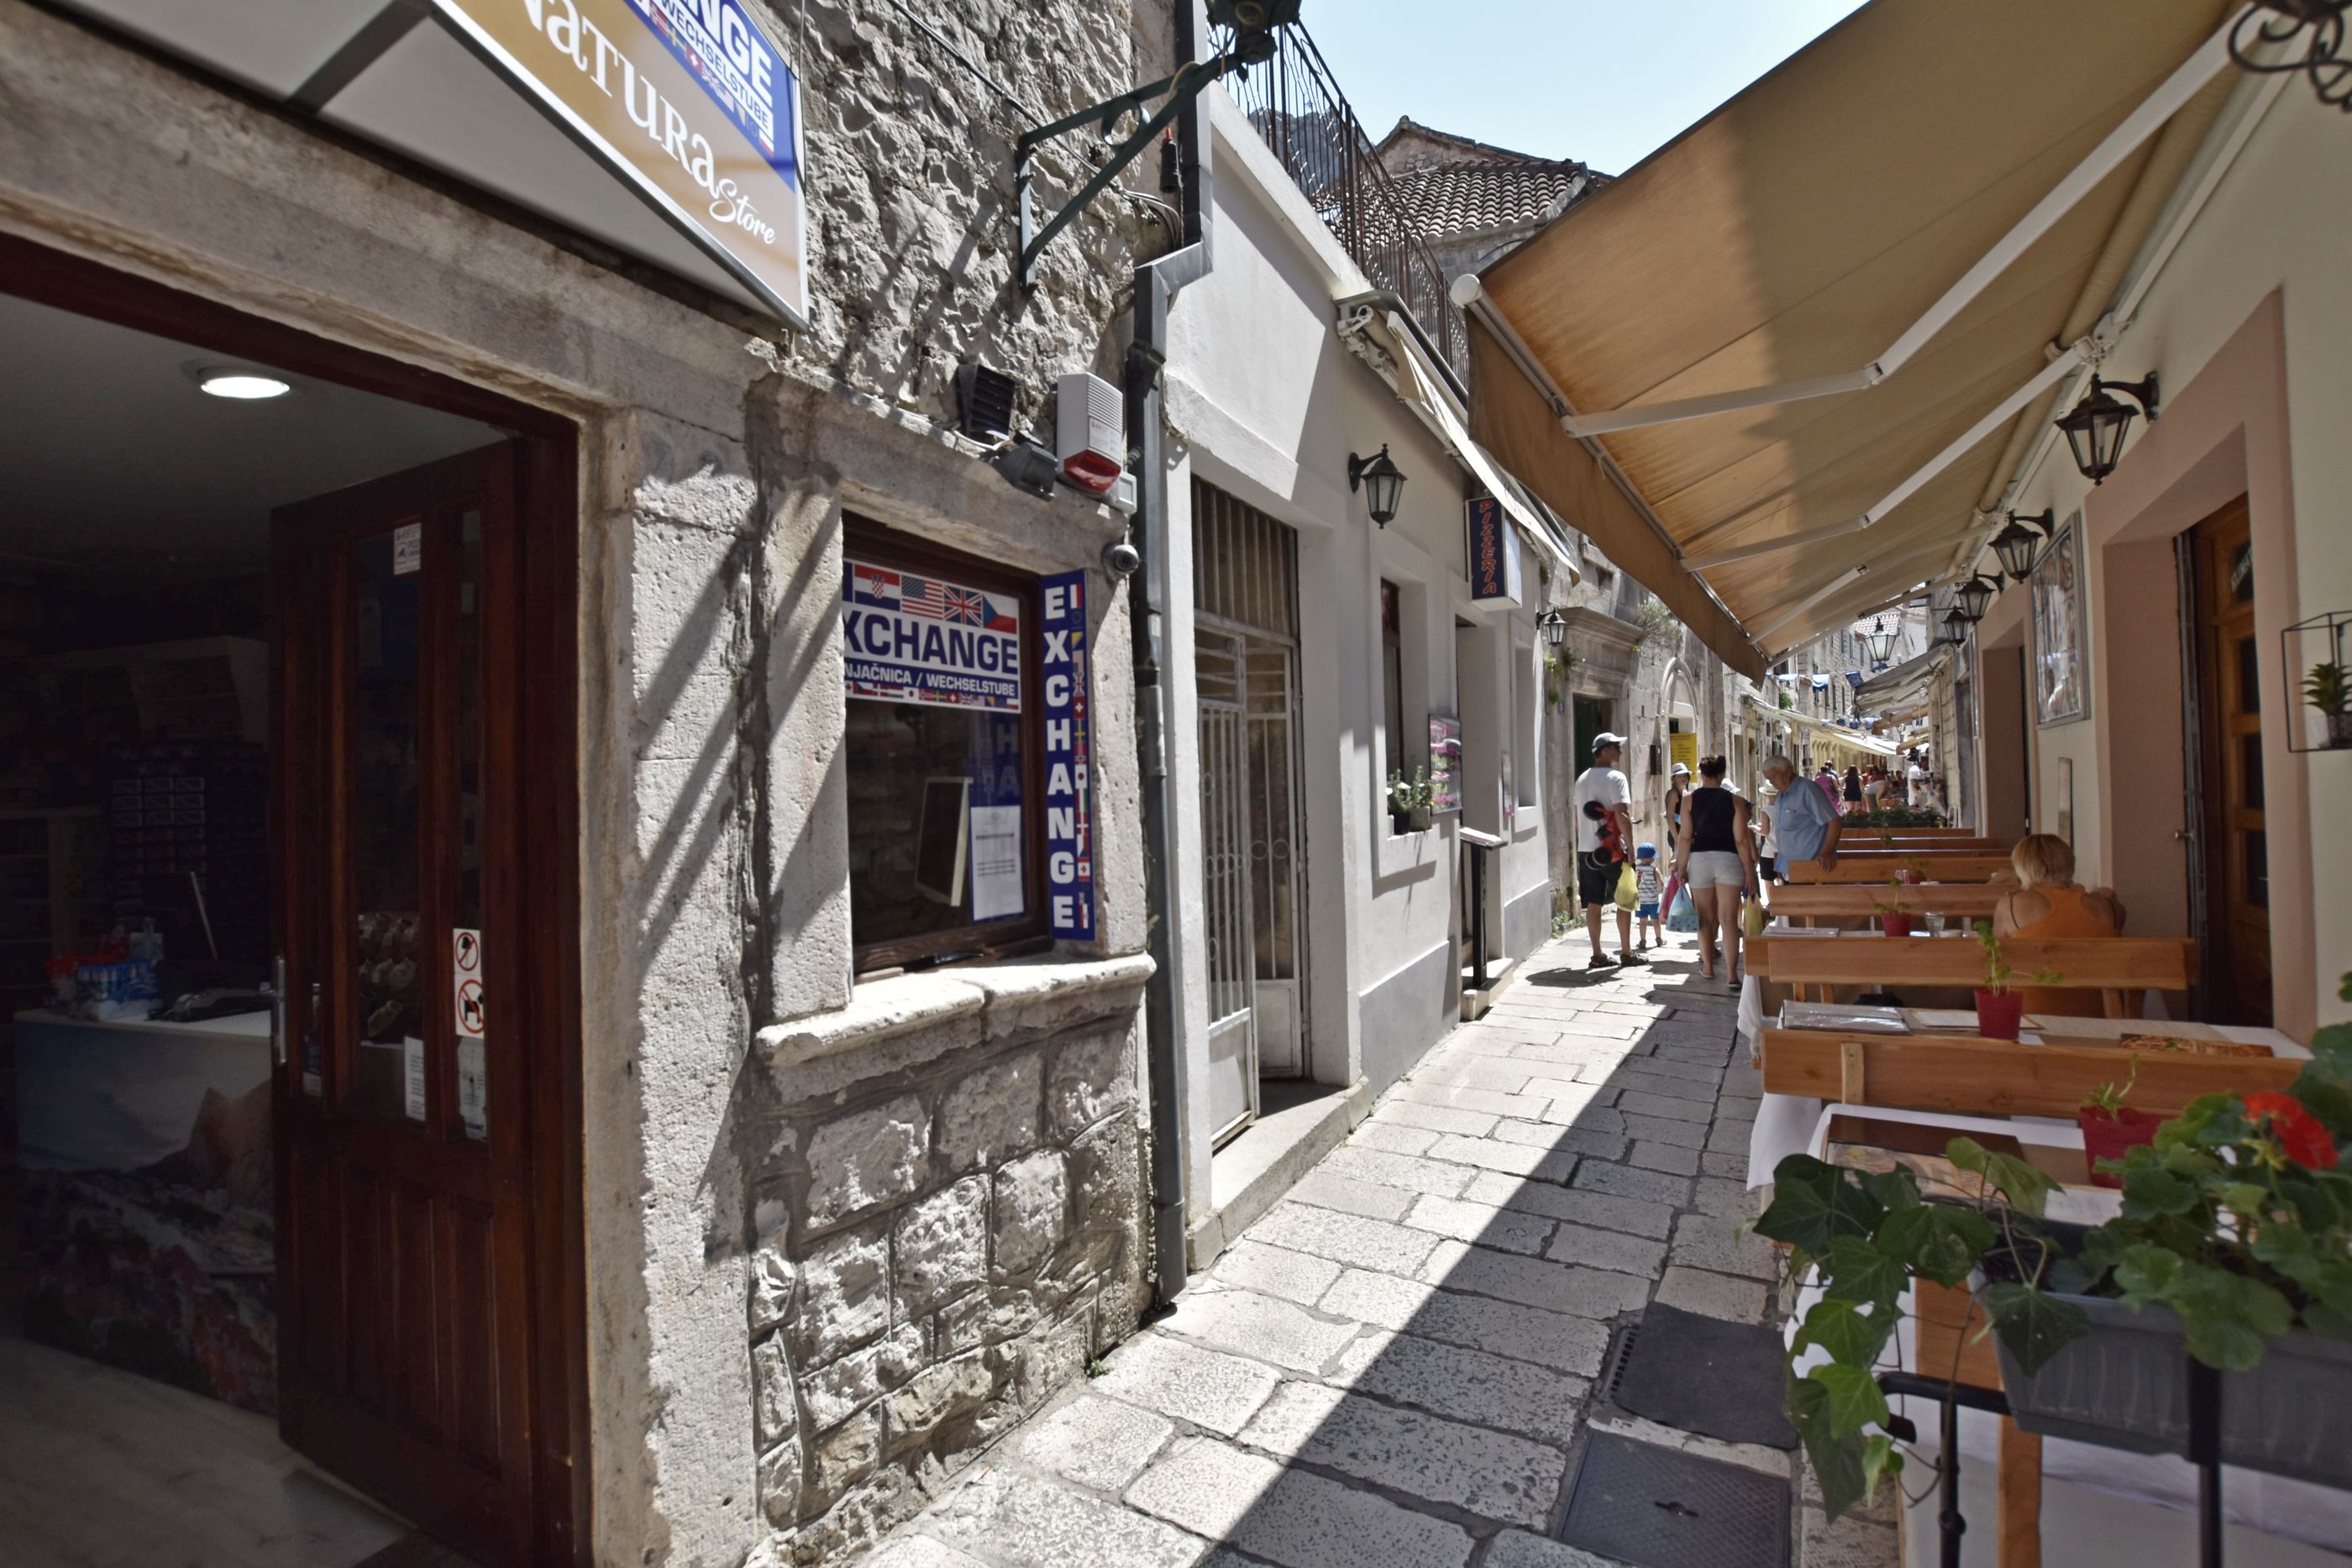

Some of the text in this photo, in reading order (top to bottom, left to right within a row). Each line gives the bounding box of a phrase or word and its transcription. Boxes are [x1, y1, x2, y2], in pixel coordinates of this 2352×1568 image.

[709, 178, 776, 244] Store
[1479, 501, 1496, 594] PIZZERIA
[926, 674, 1015, 696] WECHSELSTUBE
[1043, 586, 1074, 928] EXCHANGE
